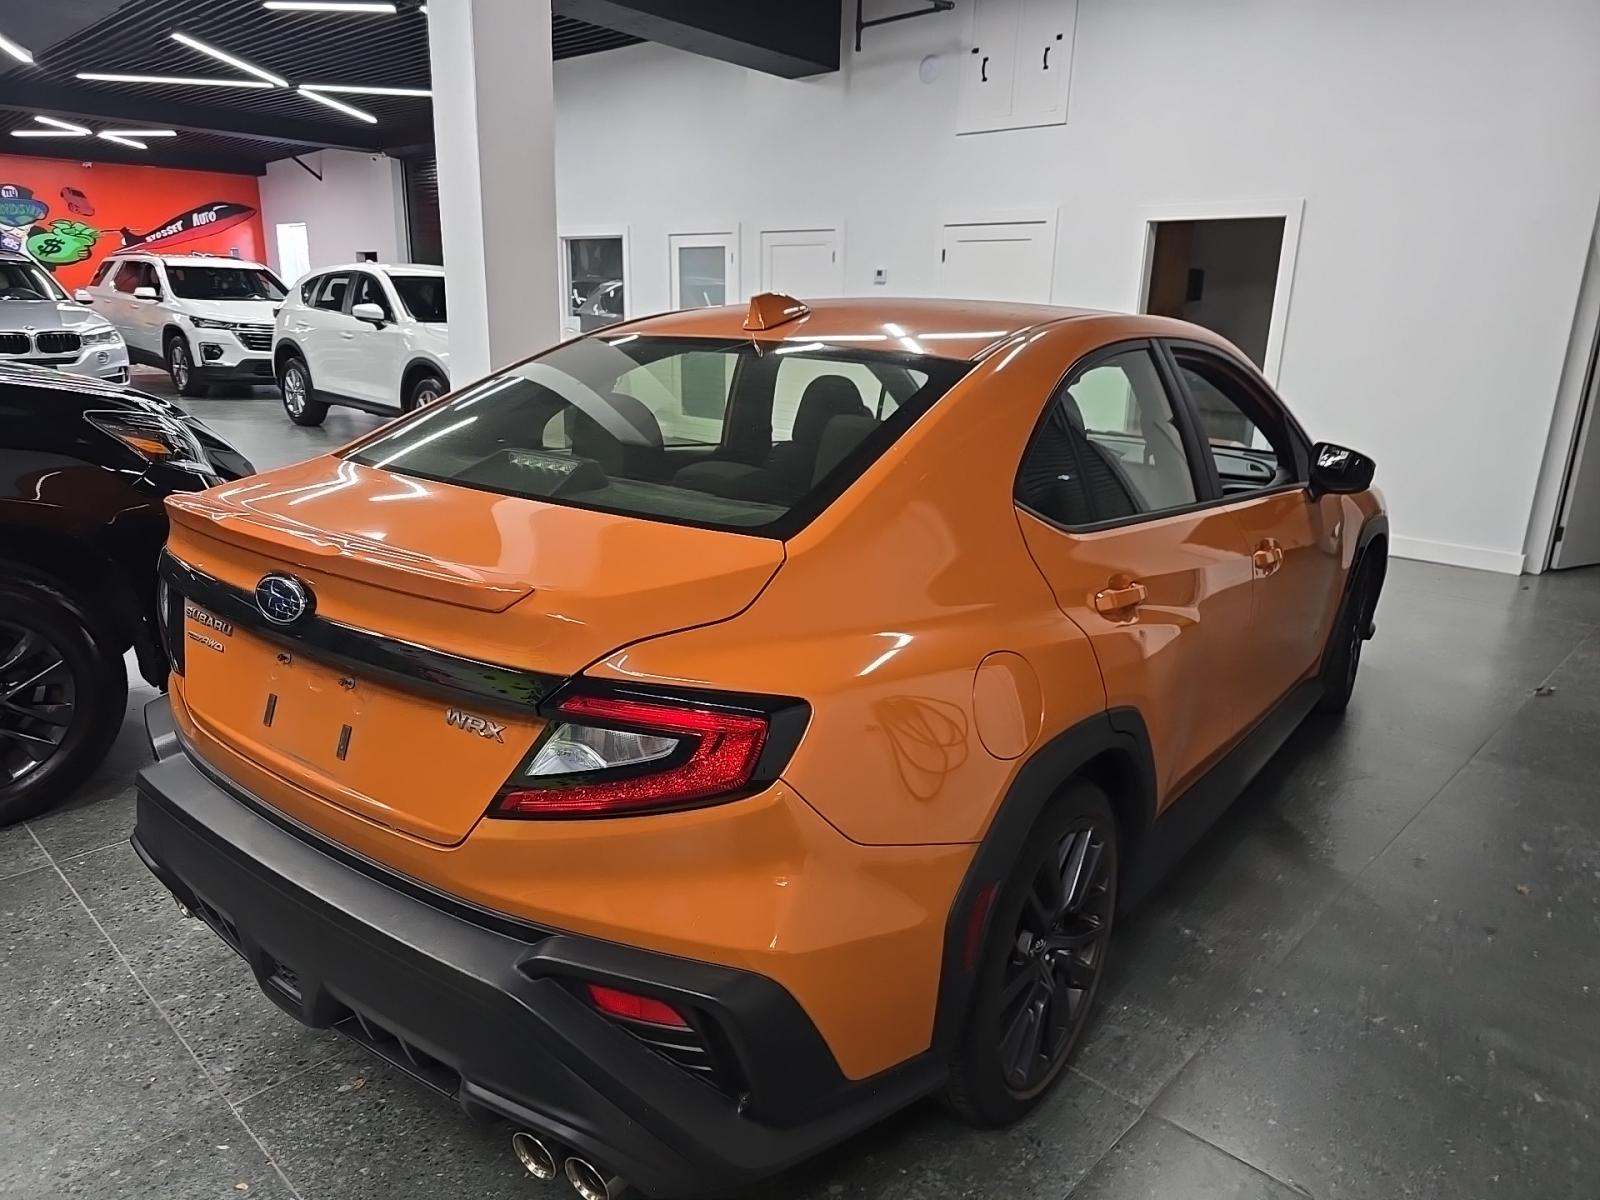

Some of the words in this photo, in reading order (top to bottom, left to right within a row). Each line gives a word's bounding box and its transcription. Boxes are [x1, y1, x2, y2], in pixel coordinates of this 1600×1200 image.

[192, 210, 217, 227] AUTO
[186, 606, 233, 637] SUBARU
[446, 708, 507, 744] WRX
